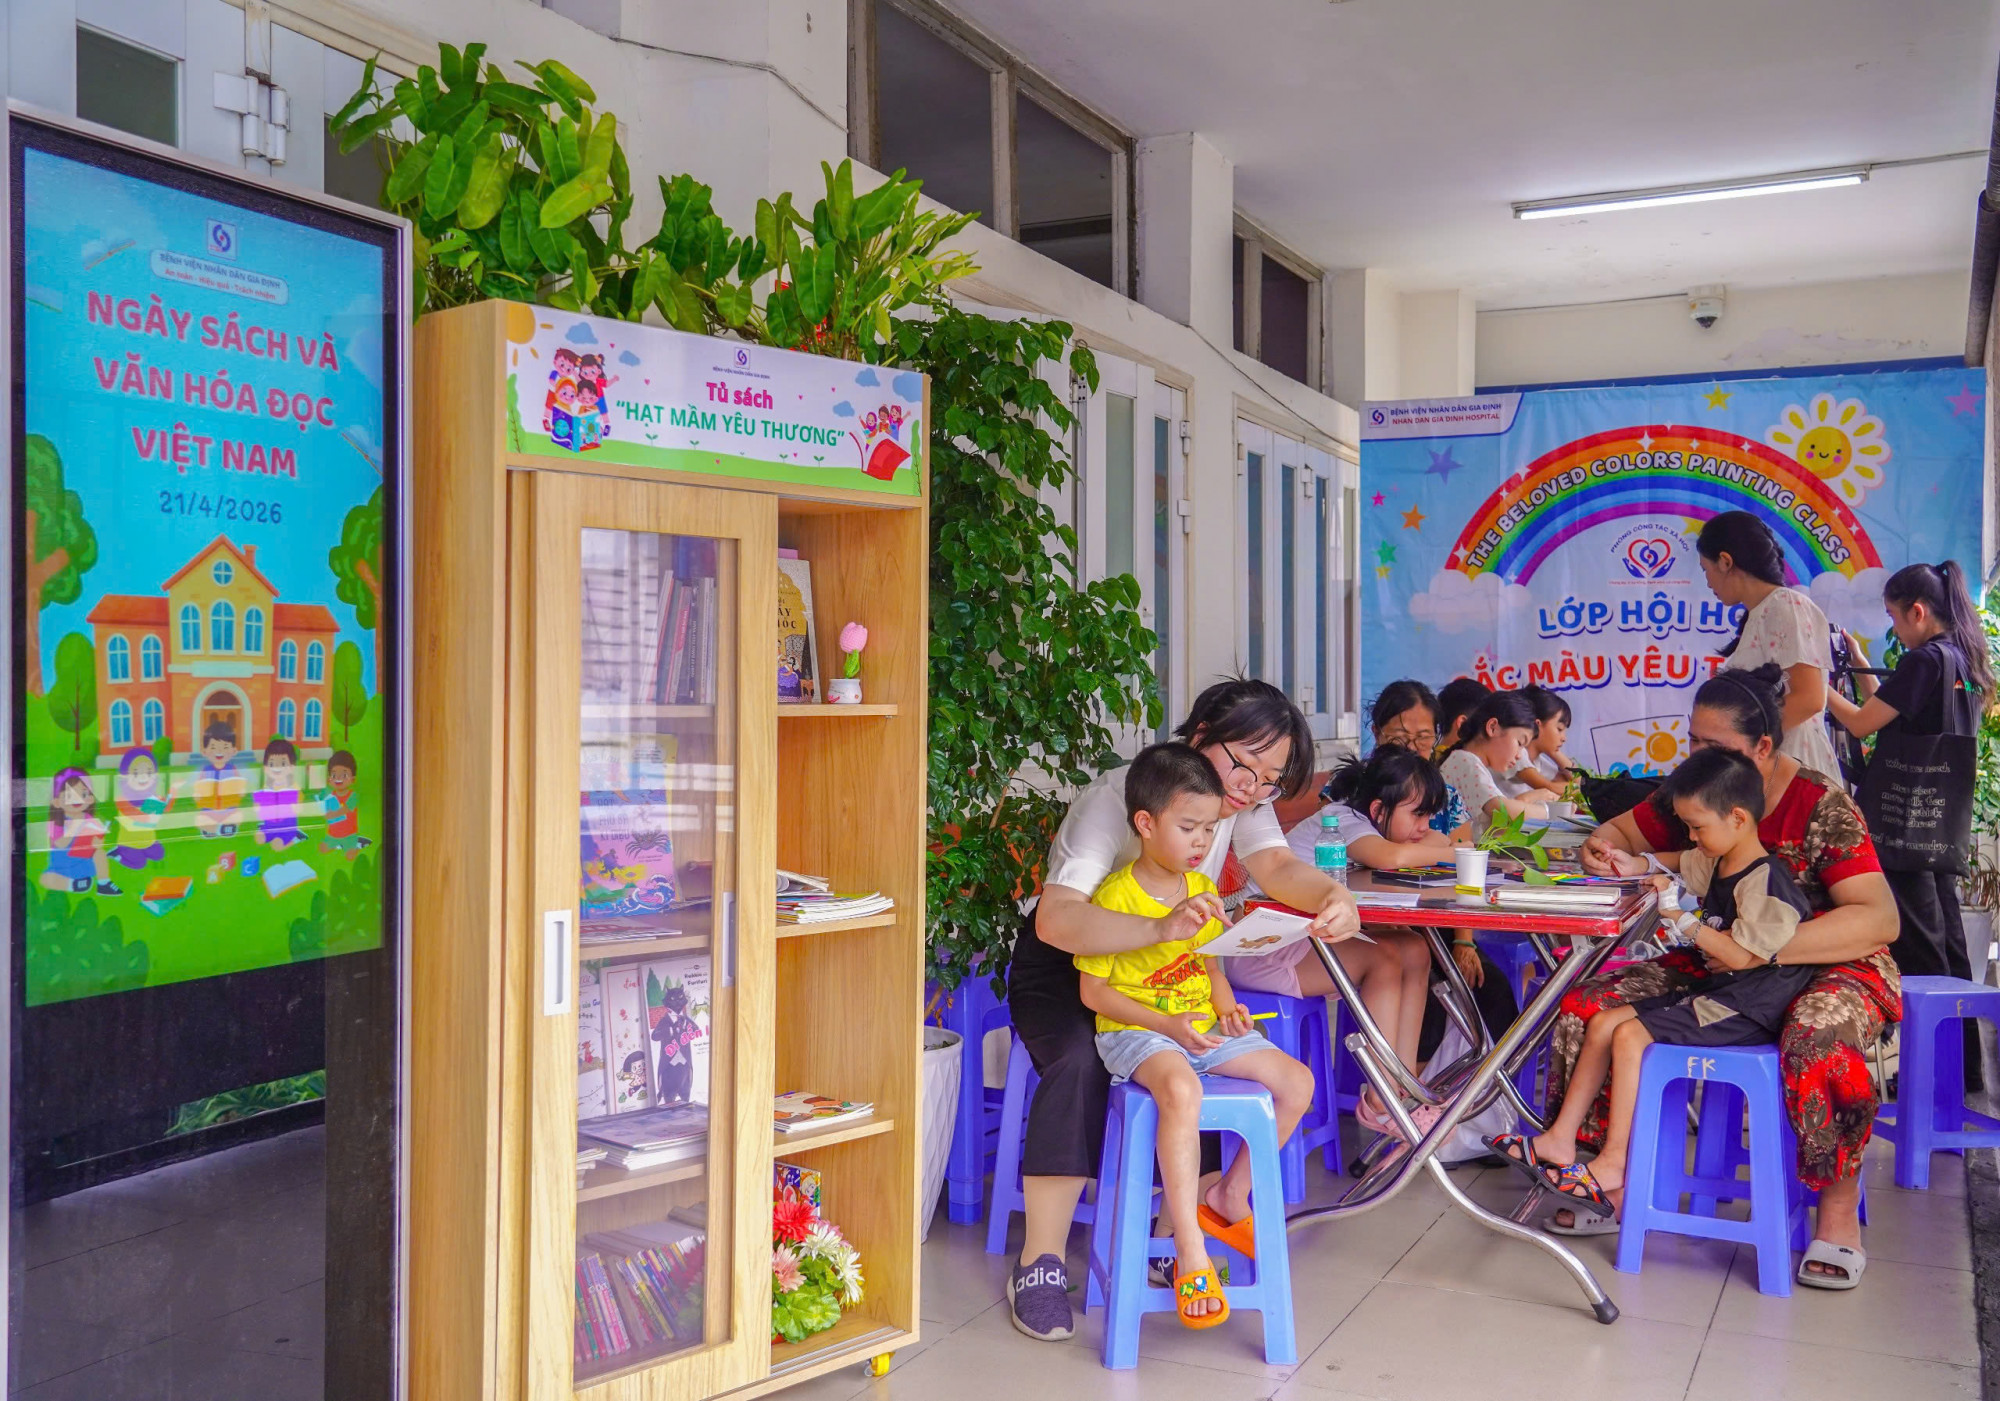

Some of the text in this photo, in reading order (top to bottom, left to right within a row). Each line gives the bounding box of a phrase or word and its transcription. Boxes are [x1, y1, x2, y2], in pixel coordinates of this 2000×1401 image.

[204, 264, 227, 276] NHÂN
[229, 269, 246, 281] DÂN
[247, 274, 259, 284] GIA
[87, 290, 339, 372] NGÀY SÁCH VÀ
[93, 351, 335, 431] VĂN HÓA ĐỌC
[705, 381, 774, 410] Tủ sách
[670, 403, 717, 432] MẦM
[722, 411, 756, 436] YÊU
[1390, 407, 1409, 417] BỆNH
[1411, 405, 1427, 416] VIỆN
[1428, 405, 1451, 414] NHÂN
[1452, 404, 1468, 413] DÂN
[1482, 403, 1502, 412] ĐỊNH
[1392, 417, 1414, 425] NHAN
[1465, 413, 1500, 422] HOSPITAL
[132, 421, 297, 478] VIỆT NAM
[159, 490, 282, 525] 21/4/2026
[1467, 451, 1851, 570] THE BELOVED COLORS PAINTING CLASS
[1632, 524, 1654, 532] CÔNG
[1655, 524, 1669, 532] TÁC
[1538, 591, 1747, 635] LỚP HỘI HỌ
[1453, 655, 1518, 693] ẮC
[1528, 650, 1606, 686] MÀU
[1617, 645, 1690, 680] YÊU
